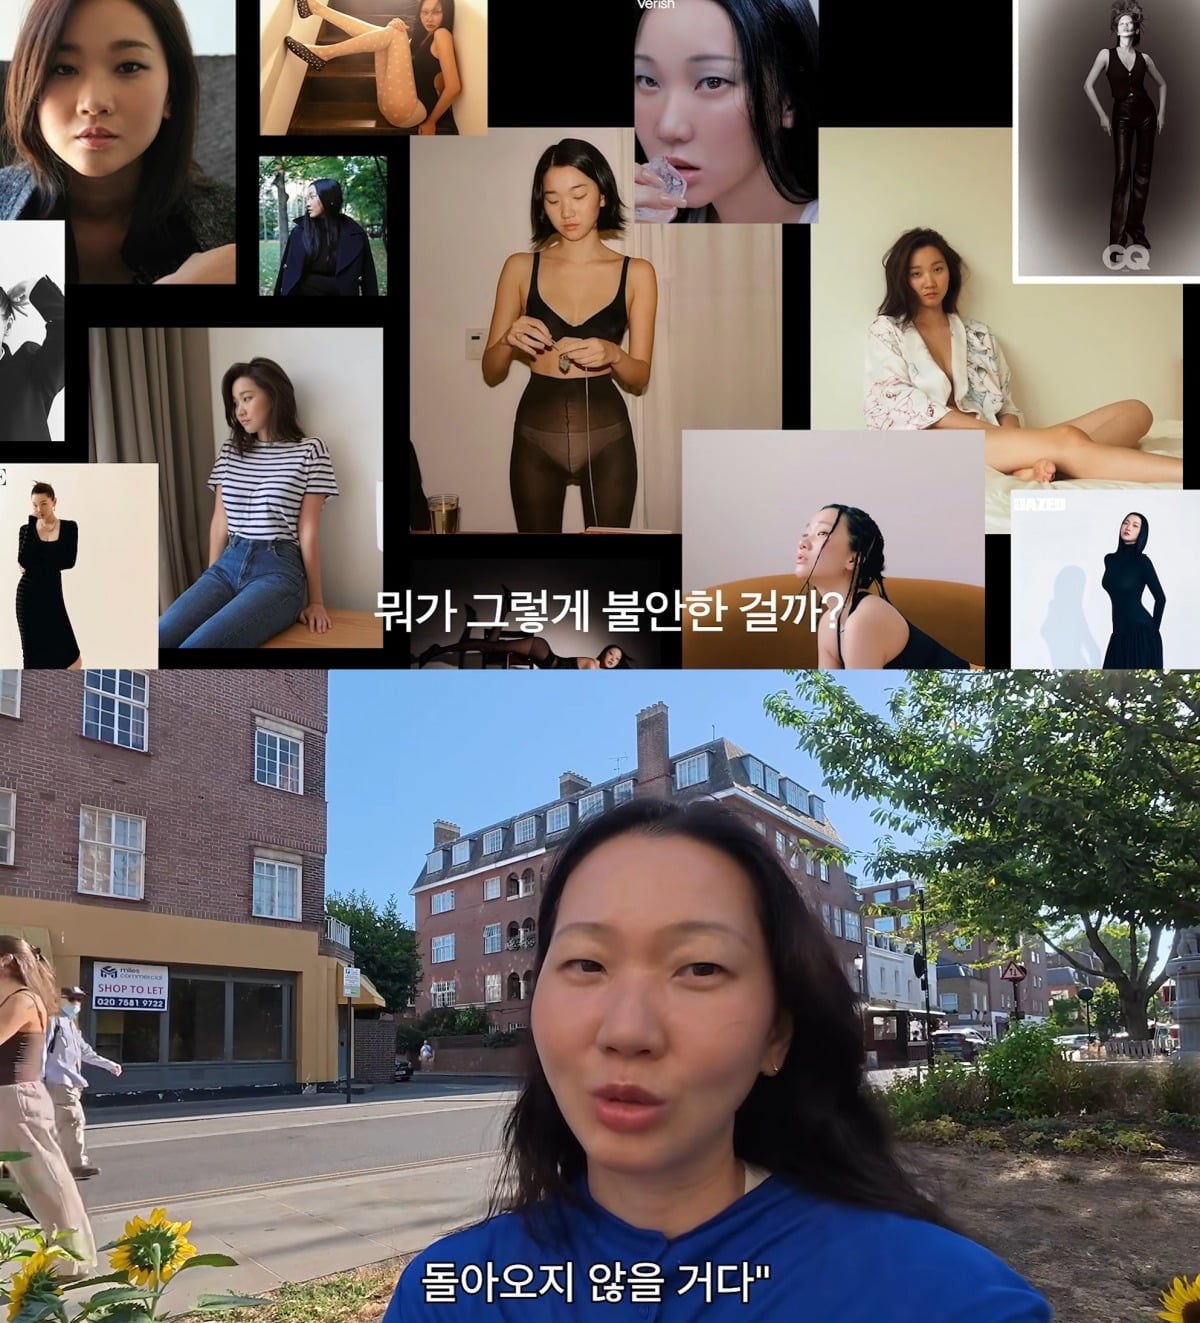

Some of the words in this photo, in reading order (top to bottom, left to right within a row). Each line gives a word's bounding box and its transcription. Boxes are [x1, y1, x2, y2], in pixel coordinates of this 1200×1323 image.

[1102, 244, 1151, 271] GQ
[1014, 497, 1066, 511] DAZED
[98, 983, 128, 993] SHOP
[129, 985, 144, 994] TO
[147, 986, 164, 995] LET
[97, 998, 115, 1006] 020
[118, 999, 139, 1007] 7581
[142, 1000, 163, 1008] 9722
